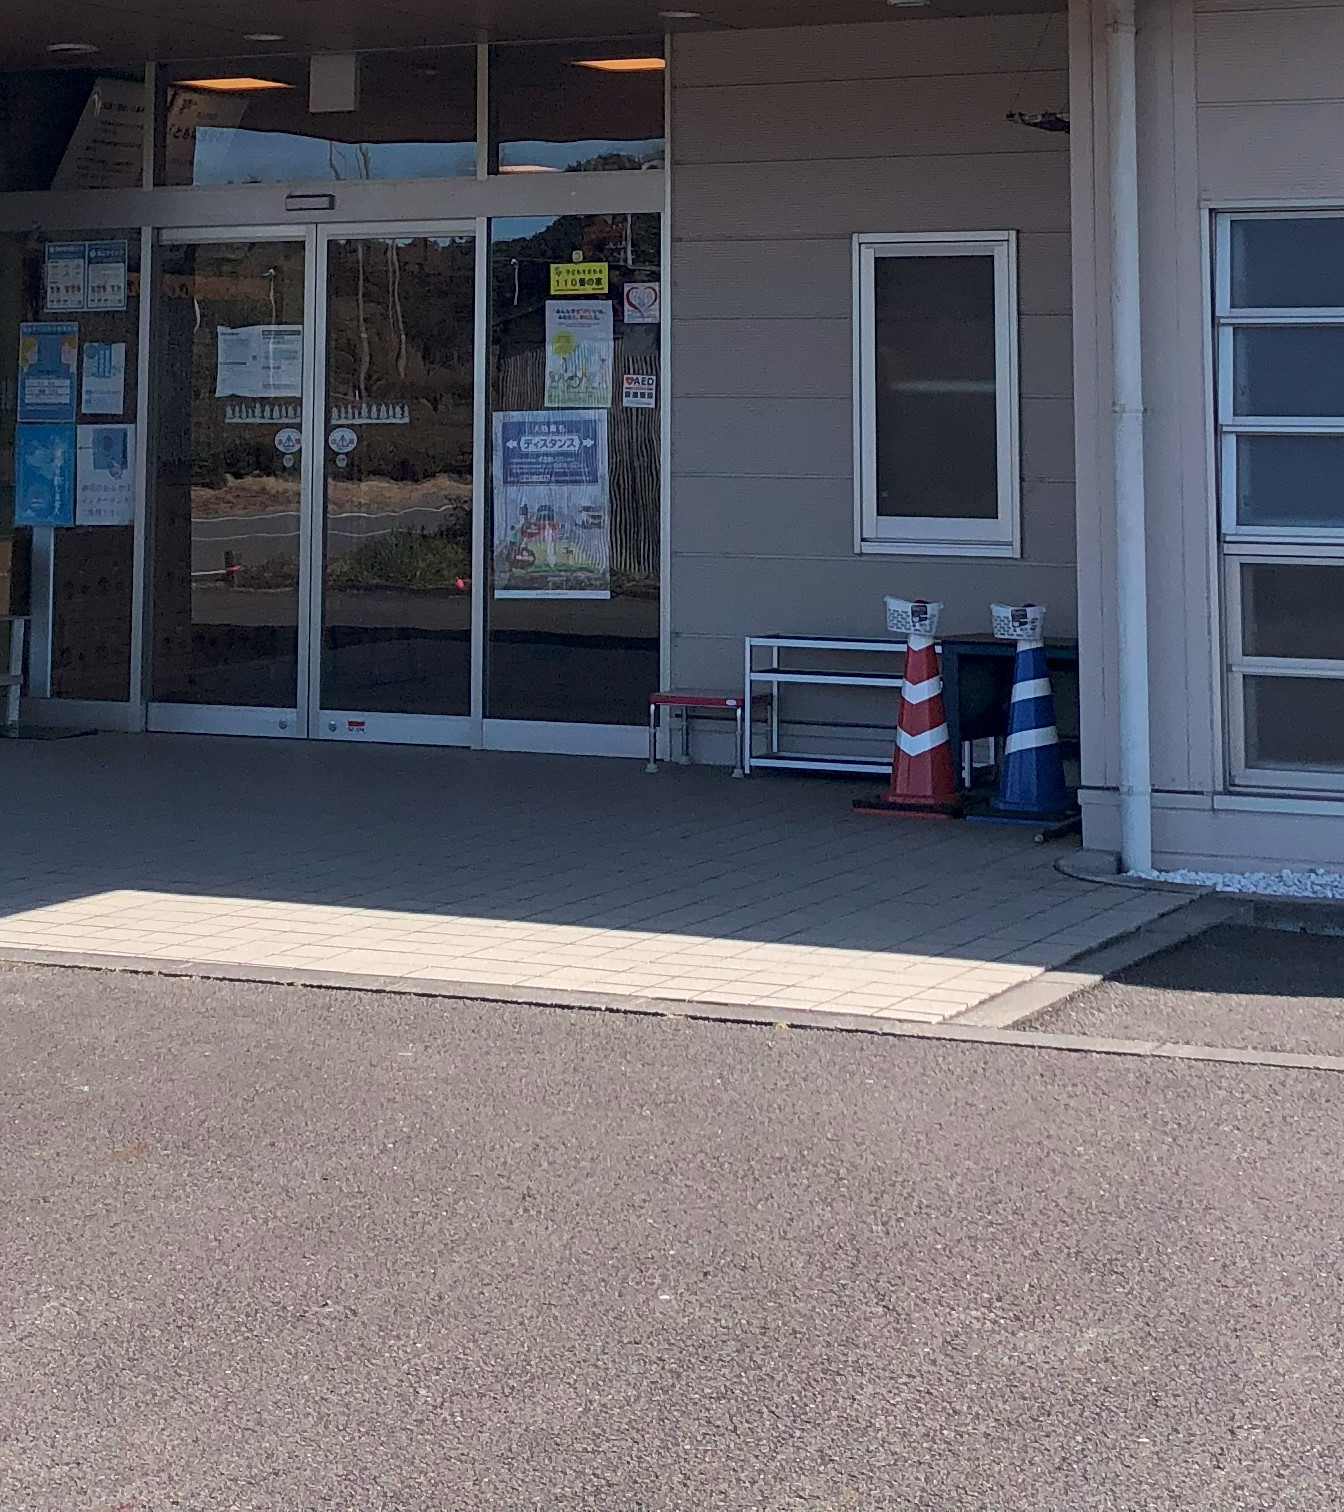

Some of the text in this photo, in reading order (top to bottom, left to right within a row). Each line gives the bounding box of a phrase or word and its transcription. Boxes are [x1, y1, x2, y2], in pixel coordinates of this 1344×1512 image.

[633, 376, 655, 386] AED
[523, 437, 577, 449] ディスタンス
